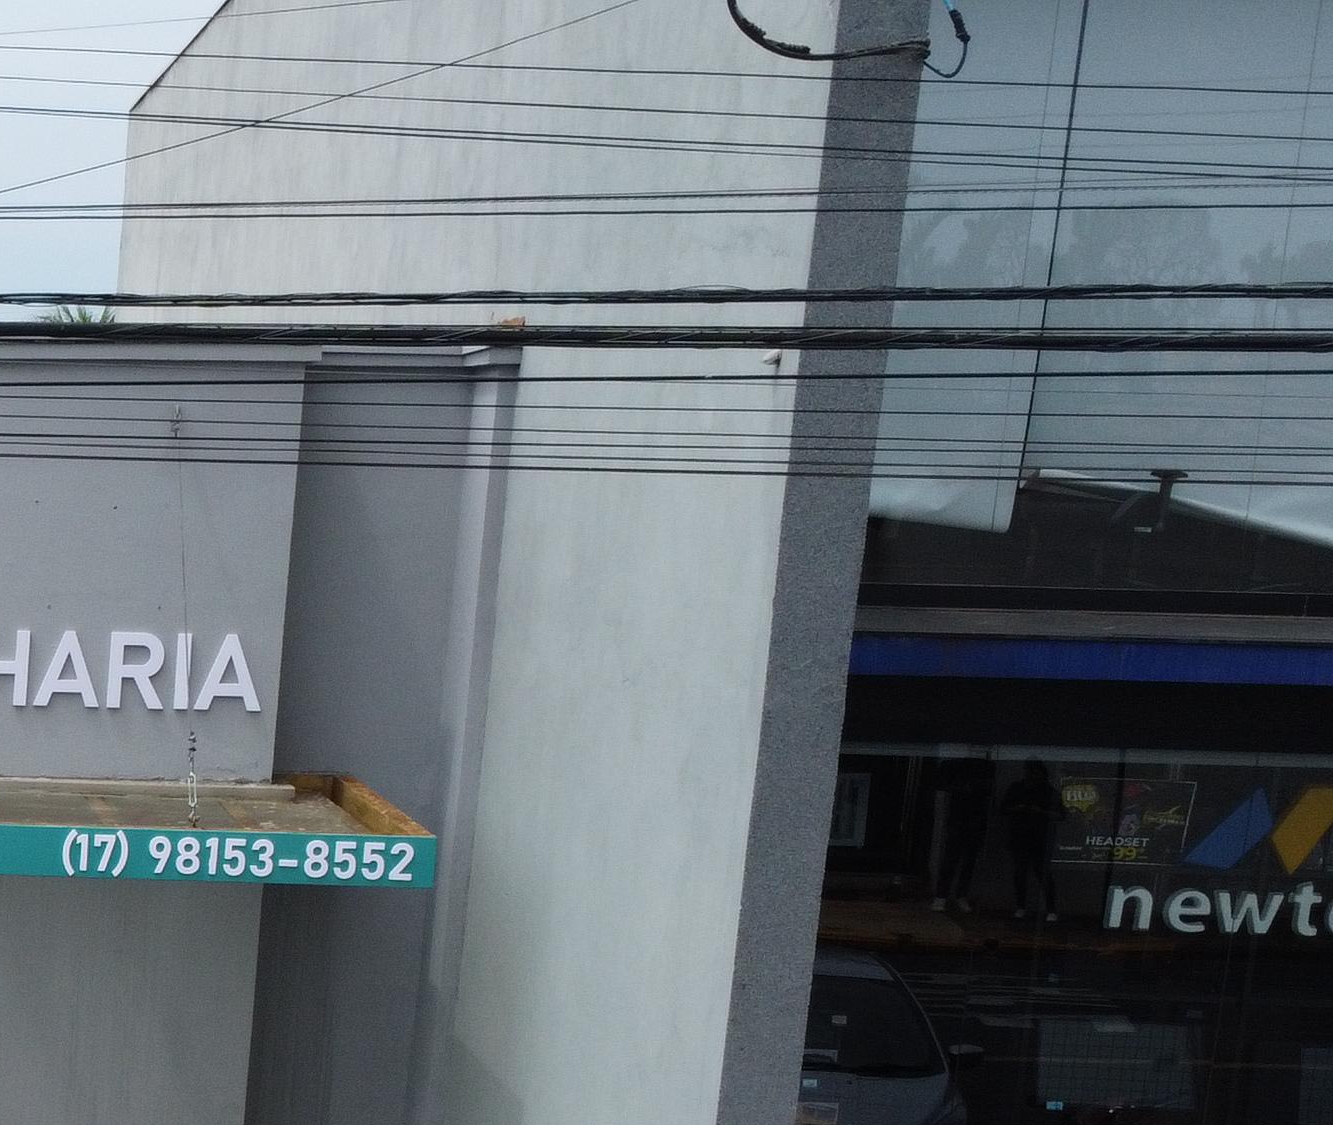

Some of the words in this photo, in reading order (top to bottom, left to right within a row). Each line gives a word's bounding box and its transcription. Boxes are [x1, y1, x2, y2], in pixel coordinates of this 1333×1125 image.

[62, 829, 130, 877] (17)
[149, 835, 415, 882] 98153-8552
[1086, 835, 1150, 847] HEADSET
[1103, 881, 1333, 936] newt
